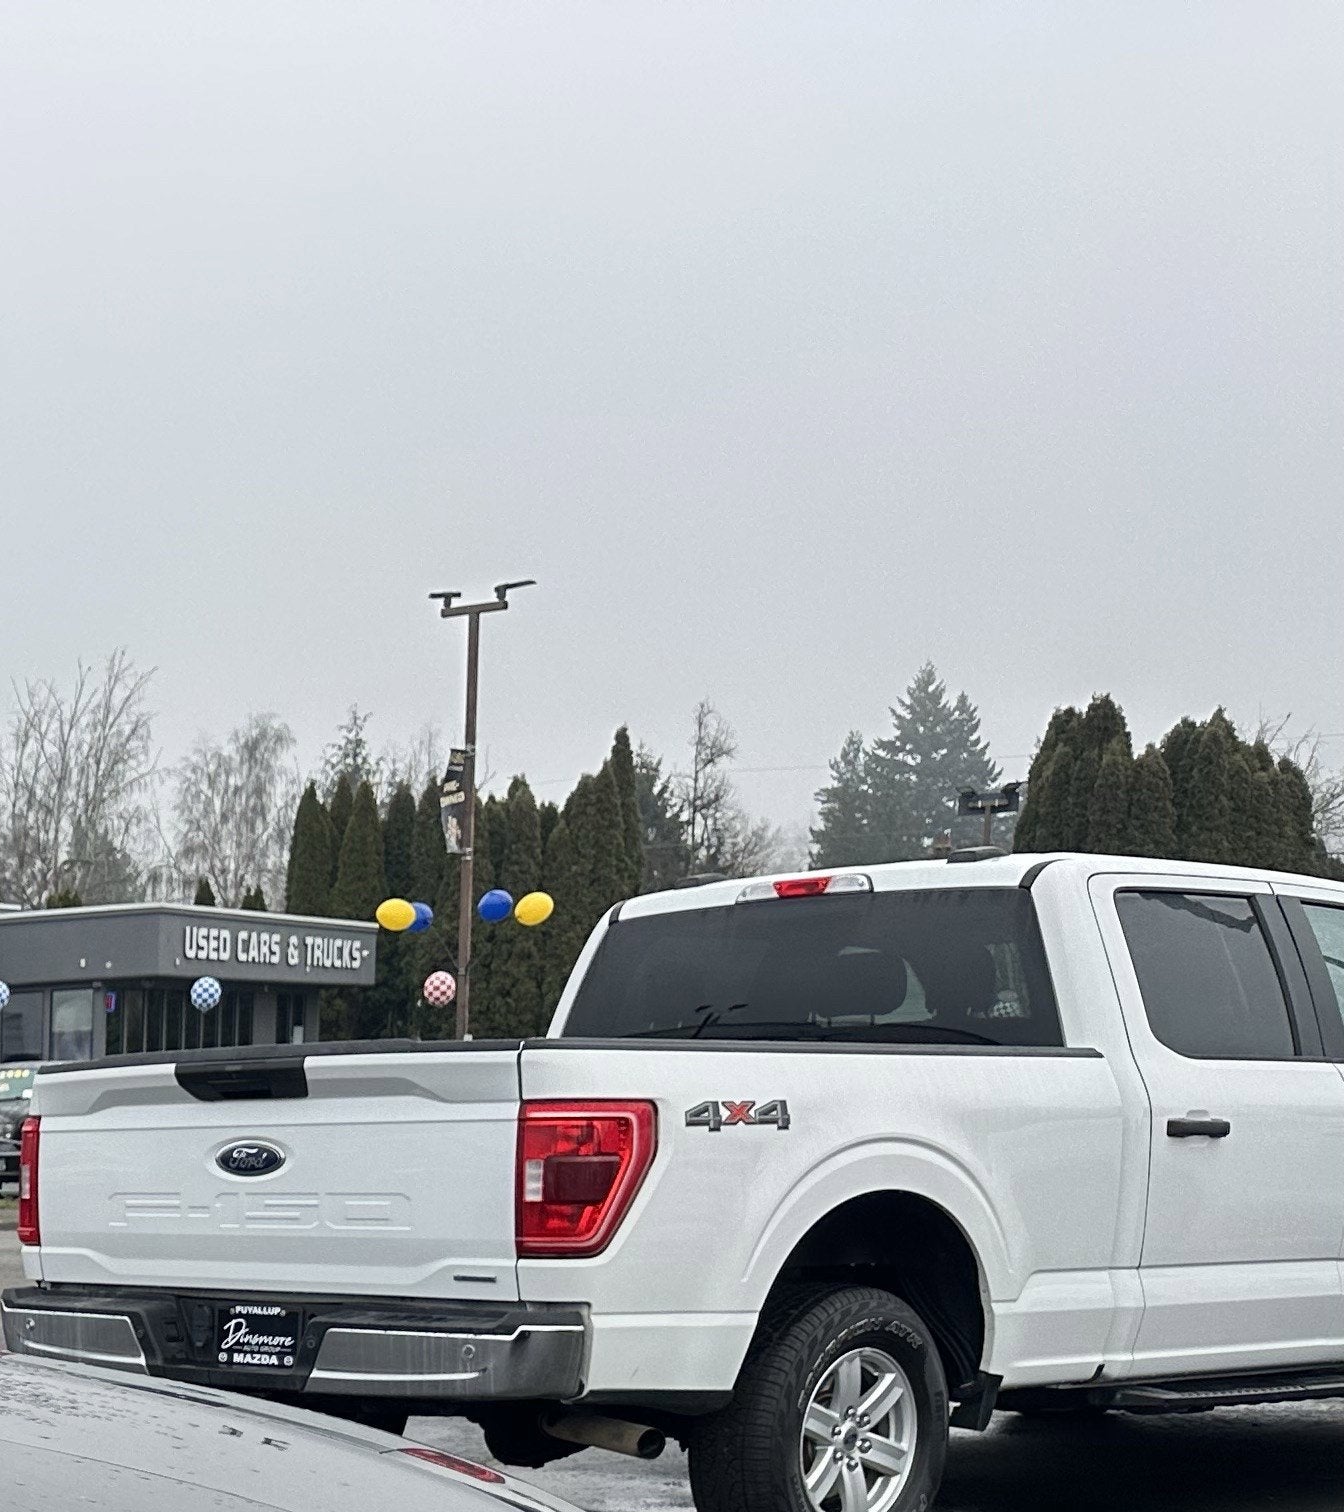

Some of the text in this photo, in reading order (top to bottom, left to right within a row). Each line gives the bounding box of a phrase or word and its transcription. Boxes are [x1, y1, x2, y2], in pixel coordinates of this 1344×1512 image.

[184, 925, 362, 969] USED CARS & TRUCKS
[228, 1147, 269, 1169] Ford
[108, 1192, 412, 1231] F-150
[235, 1305, 281, 1316] PUYALLUP
[221, 1318, 295, 1349] Dinsmore
[232, 1352, 279, 1366] MAZDA
